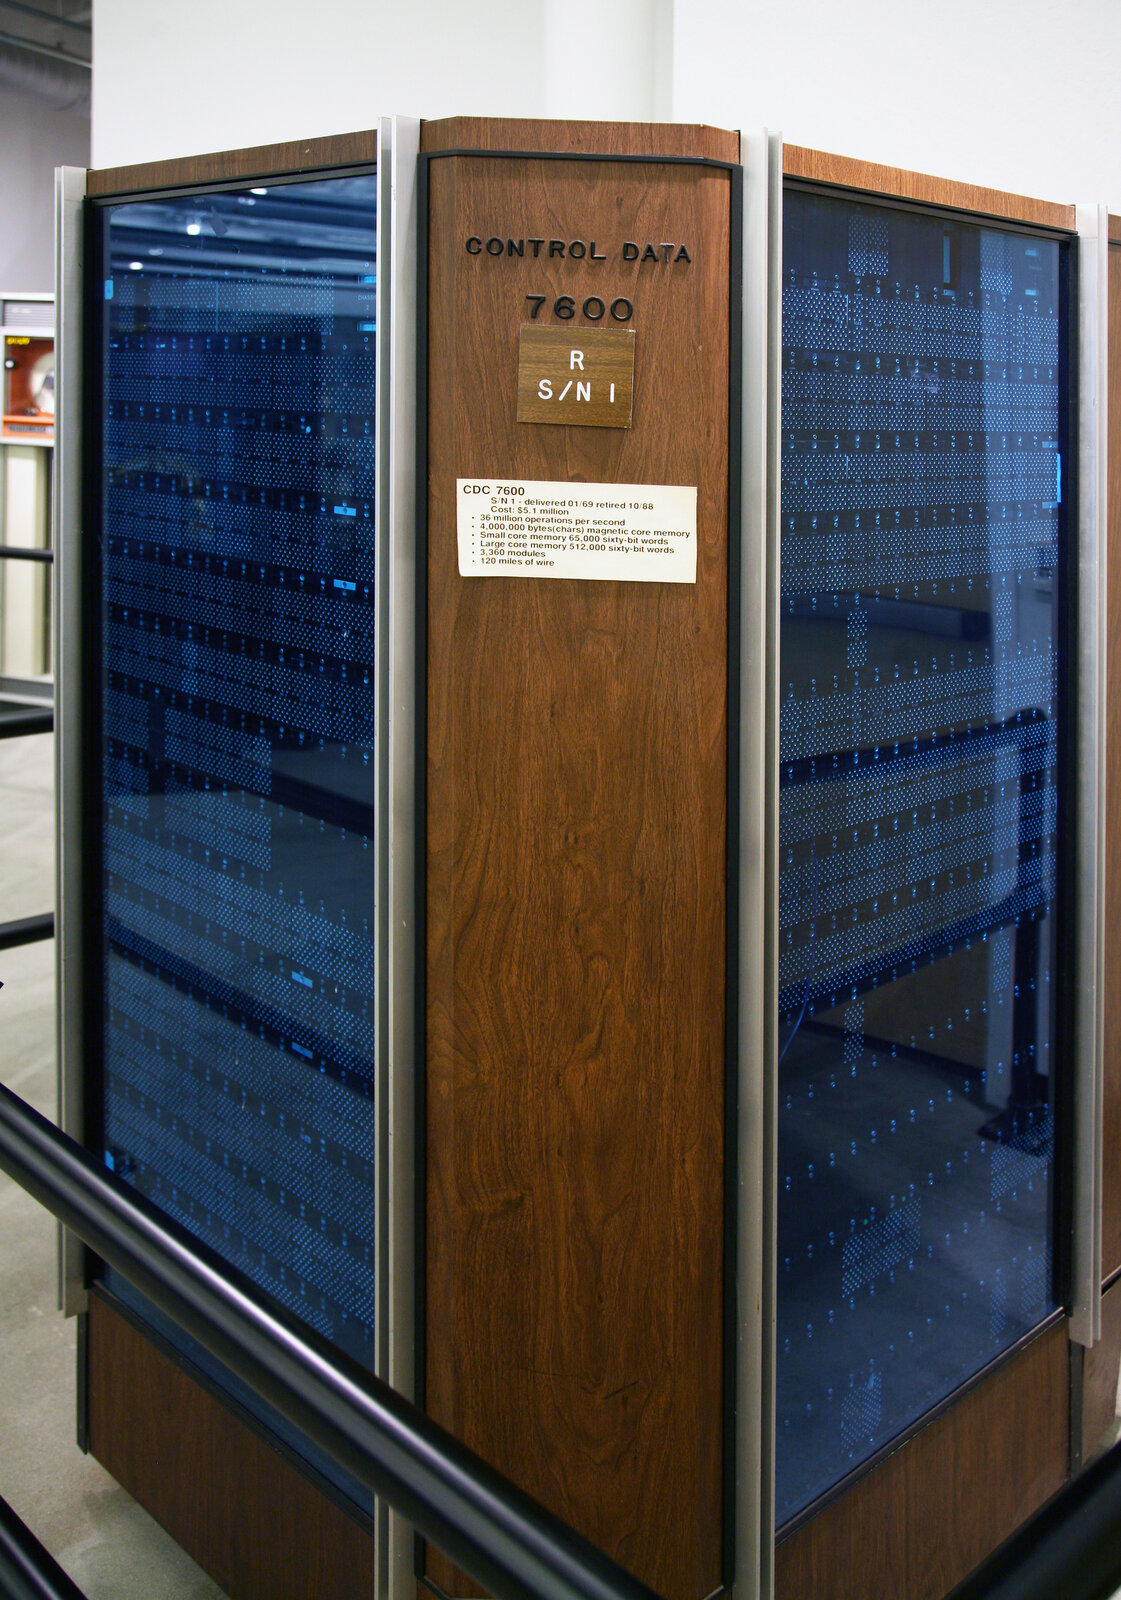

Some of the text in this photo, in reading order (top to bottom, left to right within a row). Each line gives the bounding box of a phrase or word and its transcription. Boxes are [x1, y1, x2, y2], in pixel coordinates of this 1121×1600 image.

[465, 235, 692, 263] CONTROL DATA
[525, 294, 634, 321] 7600
[570, 350, 585, 370] R
[537, 379, 591, 402] S/N
[463, 485, 525, 496] CDC 7600
[524, 498, 566, 507] delivered
[540, 507, 569, 515] million
[525, 516, 572, 524] operations
[480, 523, 525, 531] 4,000,000
[527, 524, 584, 534] bytes(chars)
[587, 527, 628, 536] magnetic
[653, 530, 690, 538] memory
[530, 534, 566, 542] memory
[569, 535, 600, 543] 65,000
[602, 536, 639, 544] sixty-bit
[480, 540, 505, 548] Large
[530, 542, 567, 551] memory
[569, 543, 606, 552] 512,000
[608, 545, 644, 553] sixty-bit
[508, 550, 546, 558] modules
